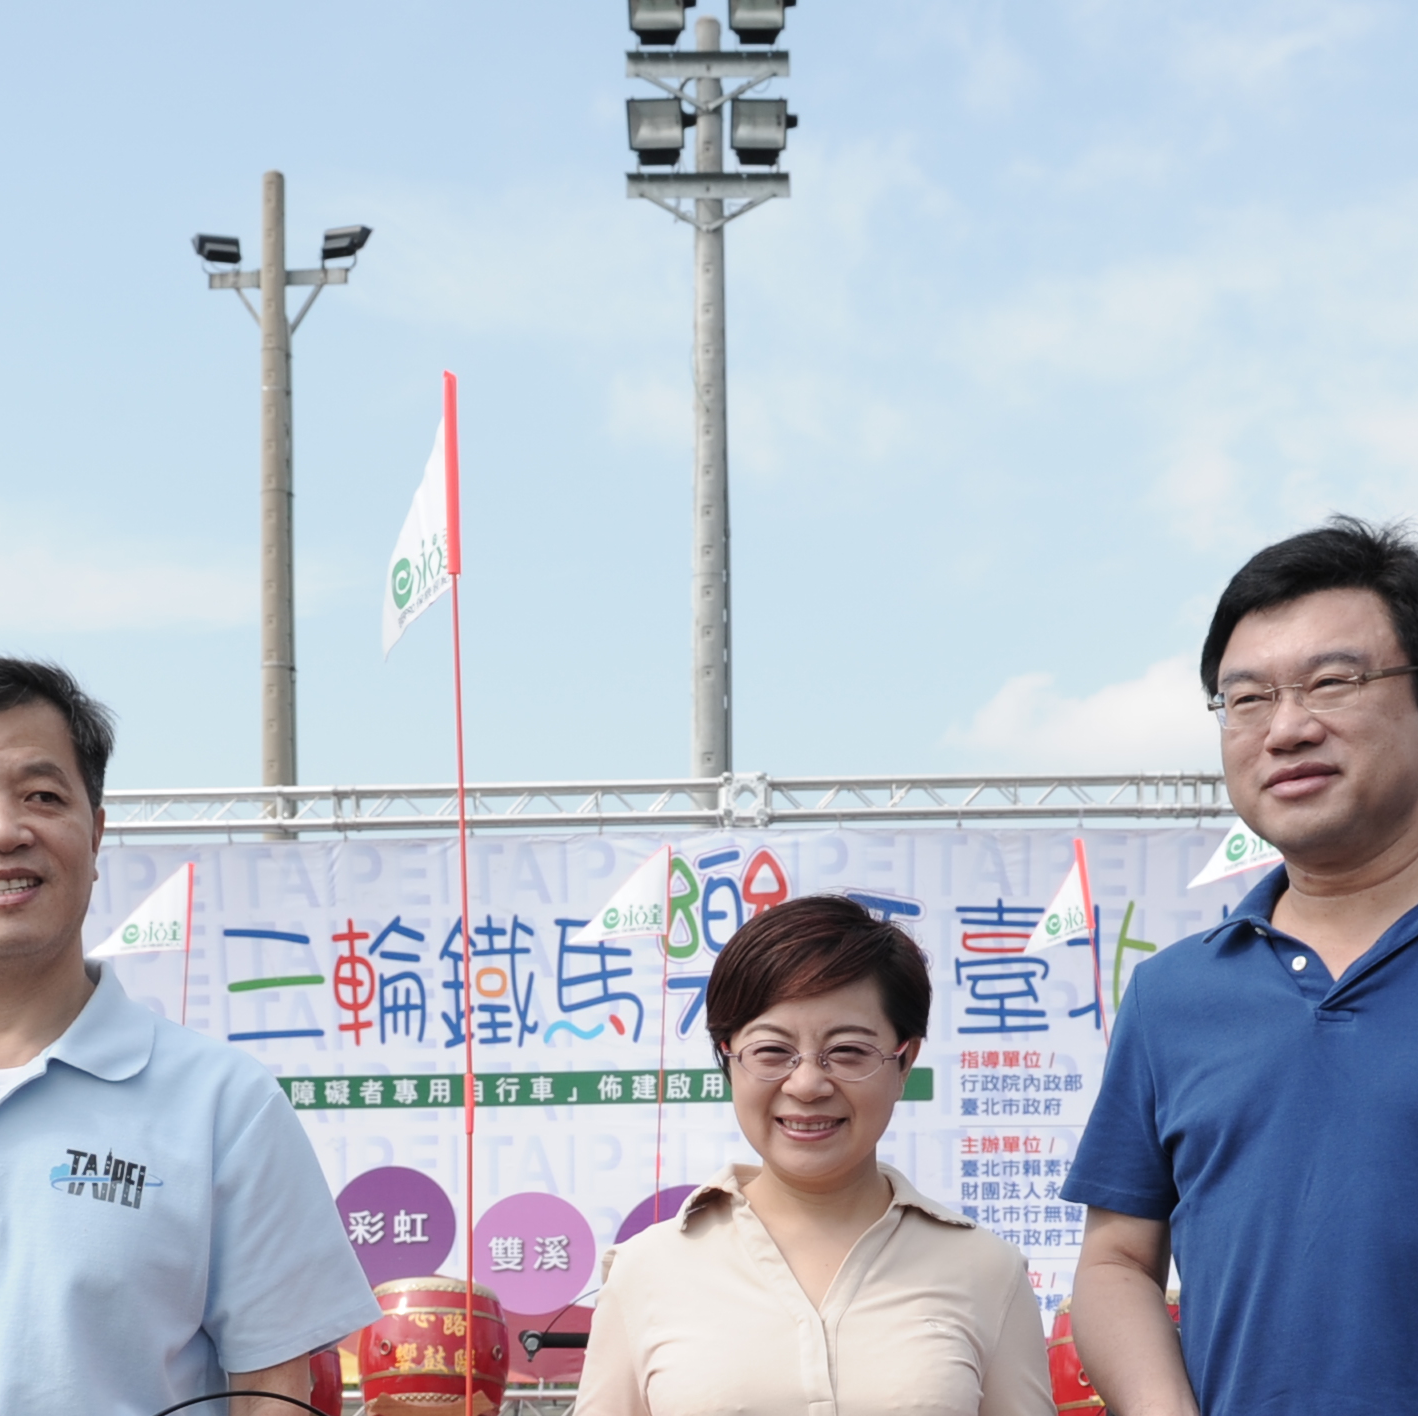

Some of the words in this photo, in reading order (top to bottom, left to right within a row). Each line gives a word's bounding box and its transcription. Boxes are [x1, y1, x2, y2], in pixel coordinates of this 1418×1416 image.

[960, 1073, 1084, 1093] 行政院內政部
[960, 1097, 1063, 1117] 臺北市政府
[66, 1147, 147, 1210] TAIPEI
[348, 1209, 430, 1246] 彩虹
[992, 1228, 1083, 1247] 市政府工
[487, 1235, 571, 1272] 雙溪
